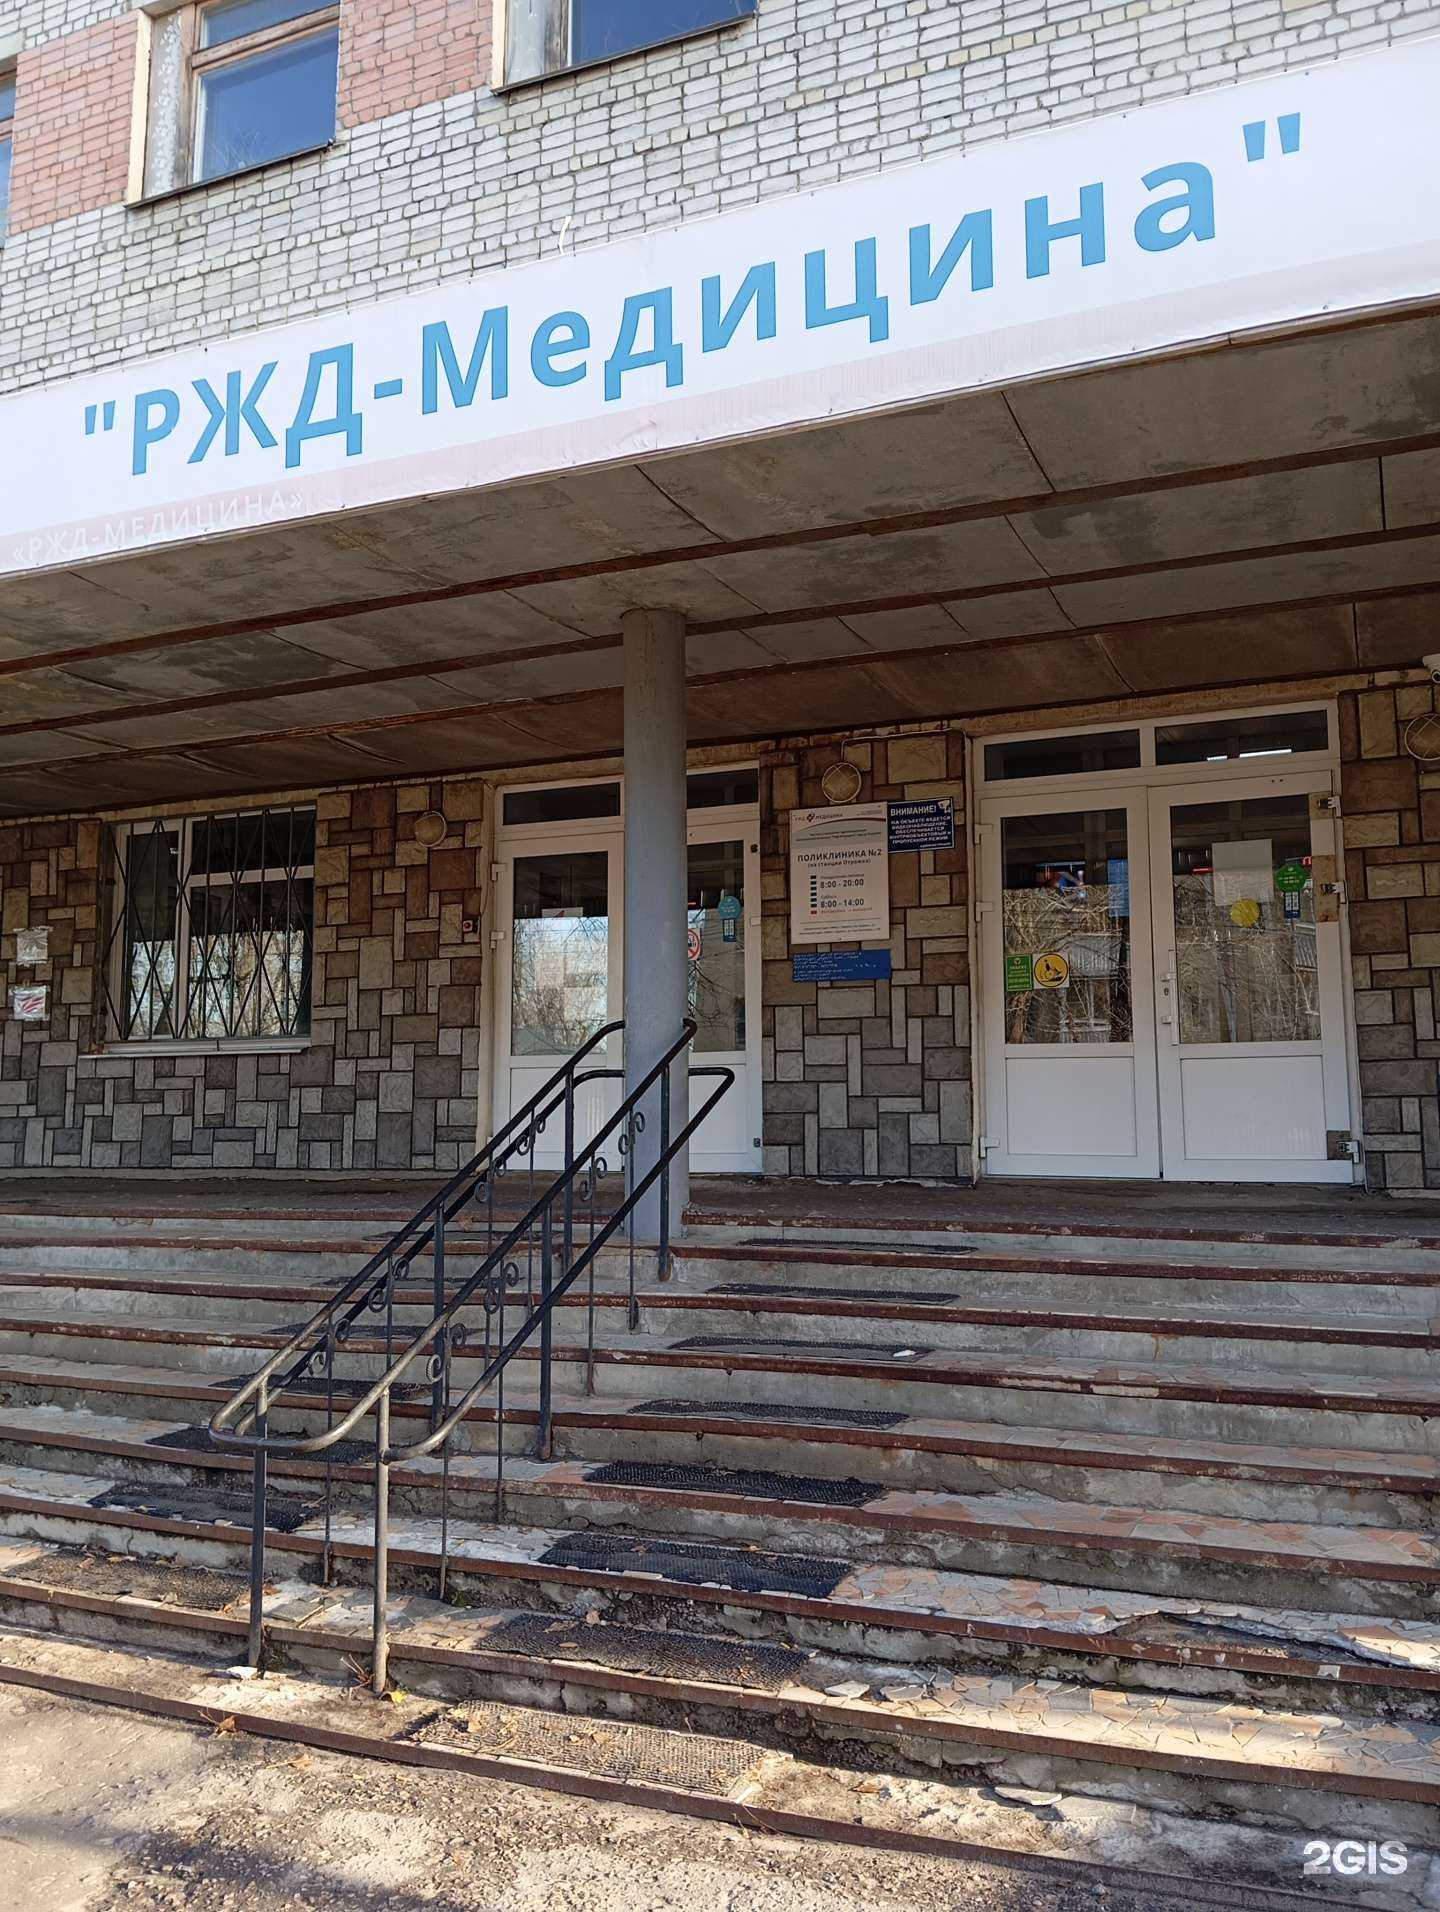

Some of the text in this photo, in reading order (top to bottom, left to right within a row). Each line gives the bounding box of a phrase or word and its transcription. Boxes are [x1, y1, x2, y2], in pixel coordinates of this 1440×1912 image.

[84, 111, 1302, 476] "РЖД-Медицина"
[890, 804, 937, 817] ВНИМАНИЕ!
[797, 850, 867, 862] ПОЛИКЛИНИКА
[820, 880, 837, 889] 8:00
[843, 878, 864, 888] 20:00
[820, 900, 837, 909] 8:00
[843, 898, 865, 907] 14:00
